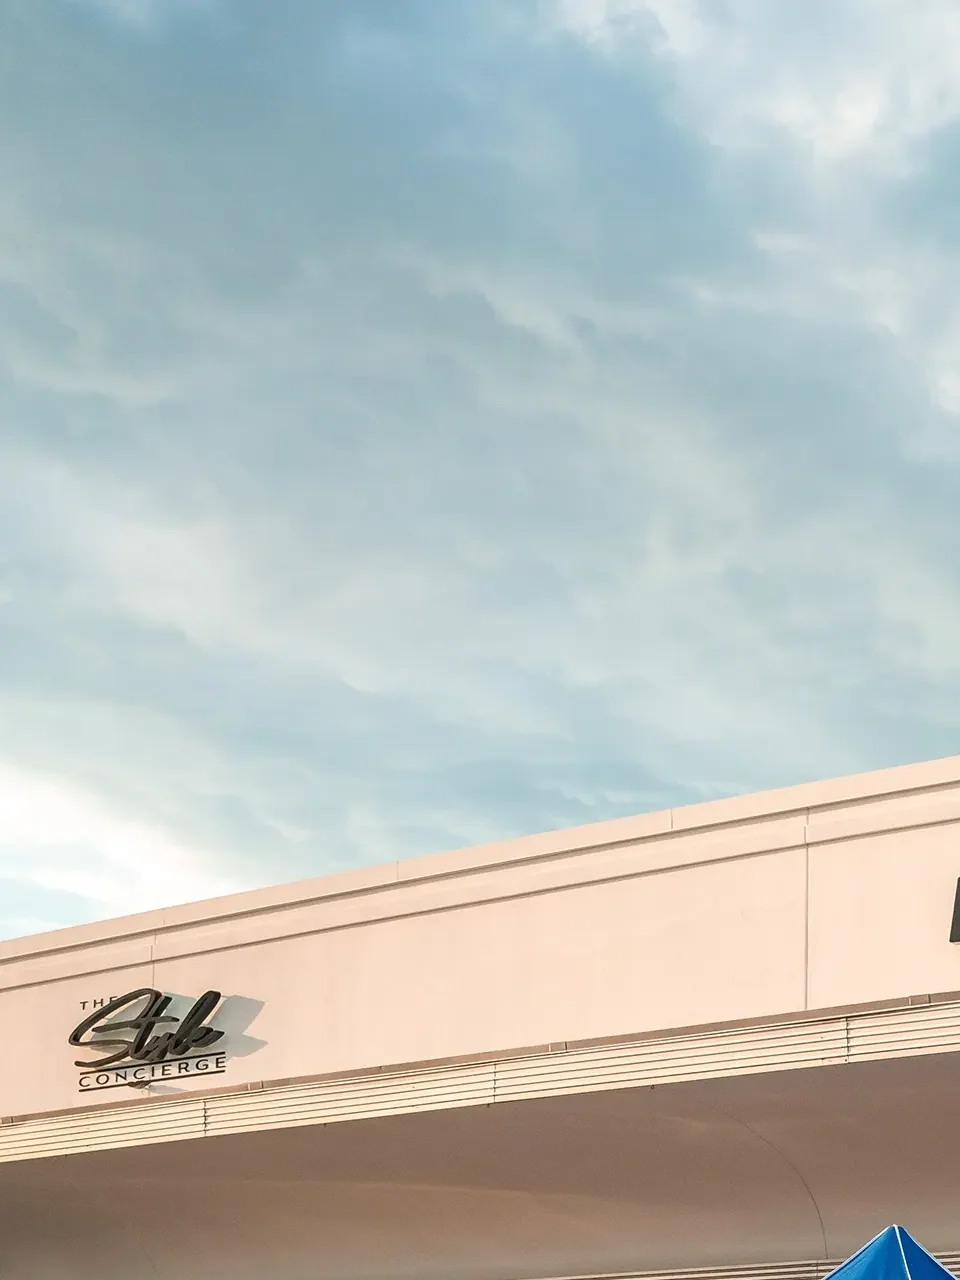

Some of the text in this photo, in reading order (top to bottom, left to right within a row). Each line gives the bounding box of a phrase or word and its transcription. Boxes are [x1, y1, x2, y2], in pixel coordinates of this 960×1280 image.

[80, 996, 118, 1011] THE
[69, 988, 225, 1068] Style
[79, 1056, 226, 1087] CONCIERGE
